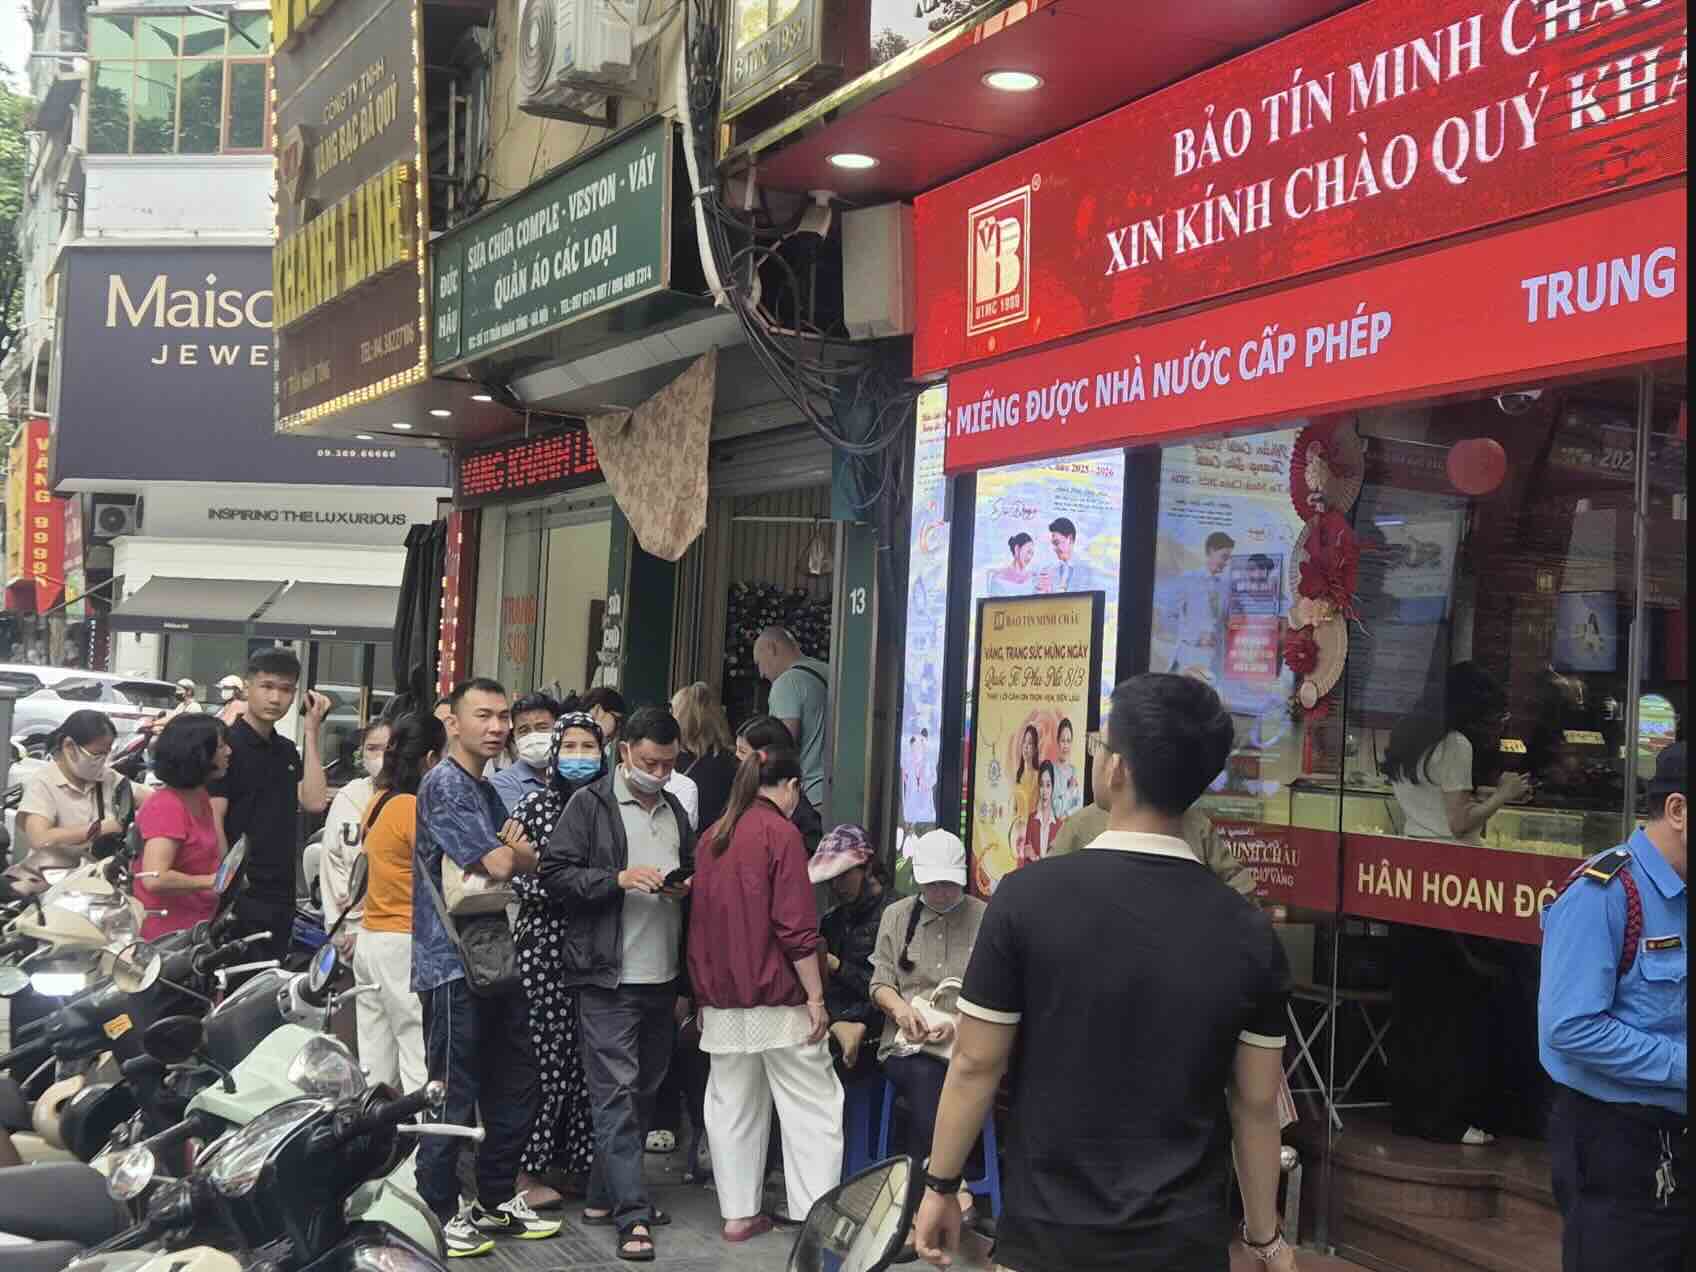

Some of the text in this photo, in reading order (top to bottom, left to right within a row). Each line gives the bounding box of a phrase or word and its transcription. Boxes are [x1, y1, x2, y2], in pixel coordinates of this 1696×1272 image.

[1174, 104, 1251, 177] BẢO
[1262, 68, 1336, 145] TÍN
[1347, 14, 1484, 115] MINH
[516, 201, 560, 249] COMPLE
[568, 172, 617, 223] VESTON
[628, 145, 657, 193] VÁY
[1104, 214, 1165, 276] XIN
[1176, 178, 1274, 254] KÍNH
[1284, 131, 1418, 219] CHÀO
[1432, 70, 1549, 185] QUÝ
[530, 250, 550, 290] ÁO
[553, 236, 580, 280] CÁC
[583, 225, 617, 267] LOẠI
[1521, 246, 1676, 323] TRUNG
[151, 344, 270, 366] JEWE
[438, 306, 458, 343] HẬU
[956, 388, 1020, 437] MIẾNG
[1025, 378, 1089, 425] ĐƯỢC
[1095, 354, 1146, 409] NHÀ
[1152, 339, 1232, 398] NƯỚC
[1239, 323, 1297, 381] CẤP
[1304, 302, 1392, 368] PHÉP
[208, 508, 407, 526] INSPIRING THE LUXURIOUS
[850, 586, 866, 615] 13
[1357, 858, 1412, 900] HÂN
[1421, 871, 1504, 915] HOAN
